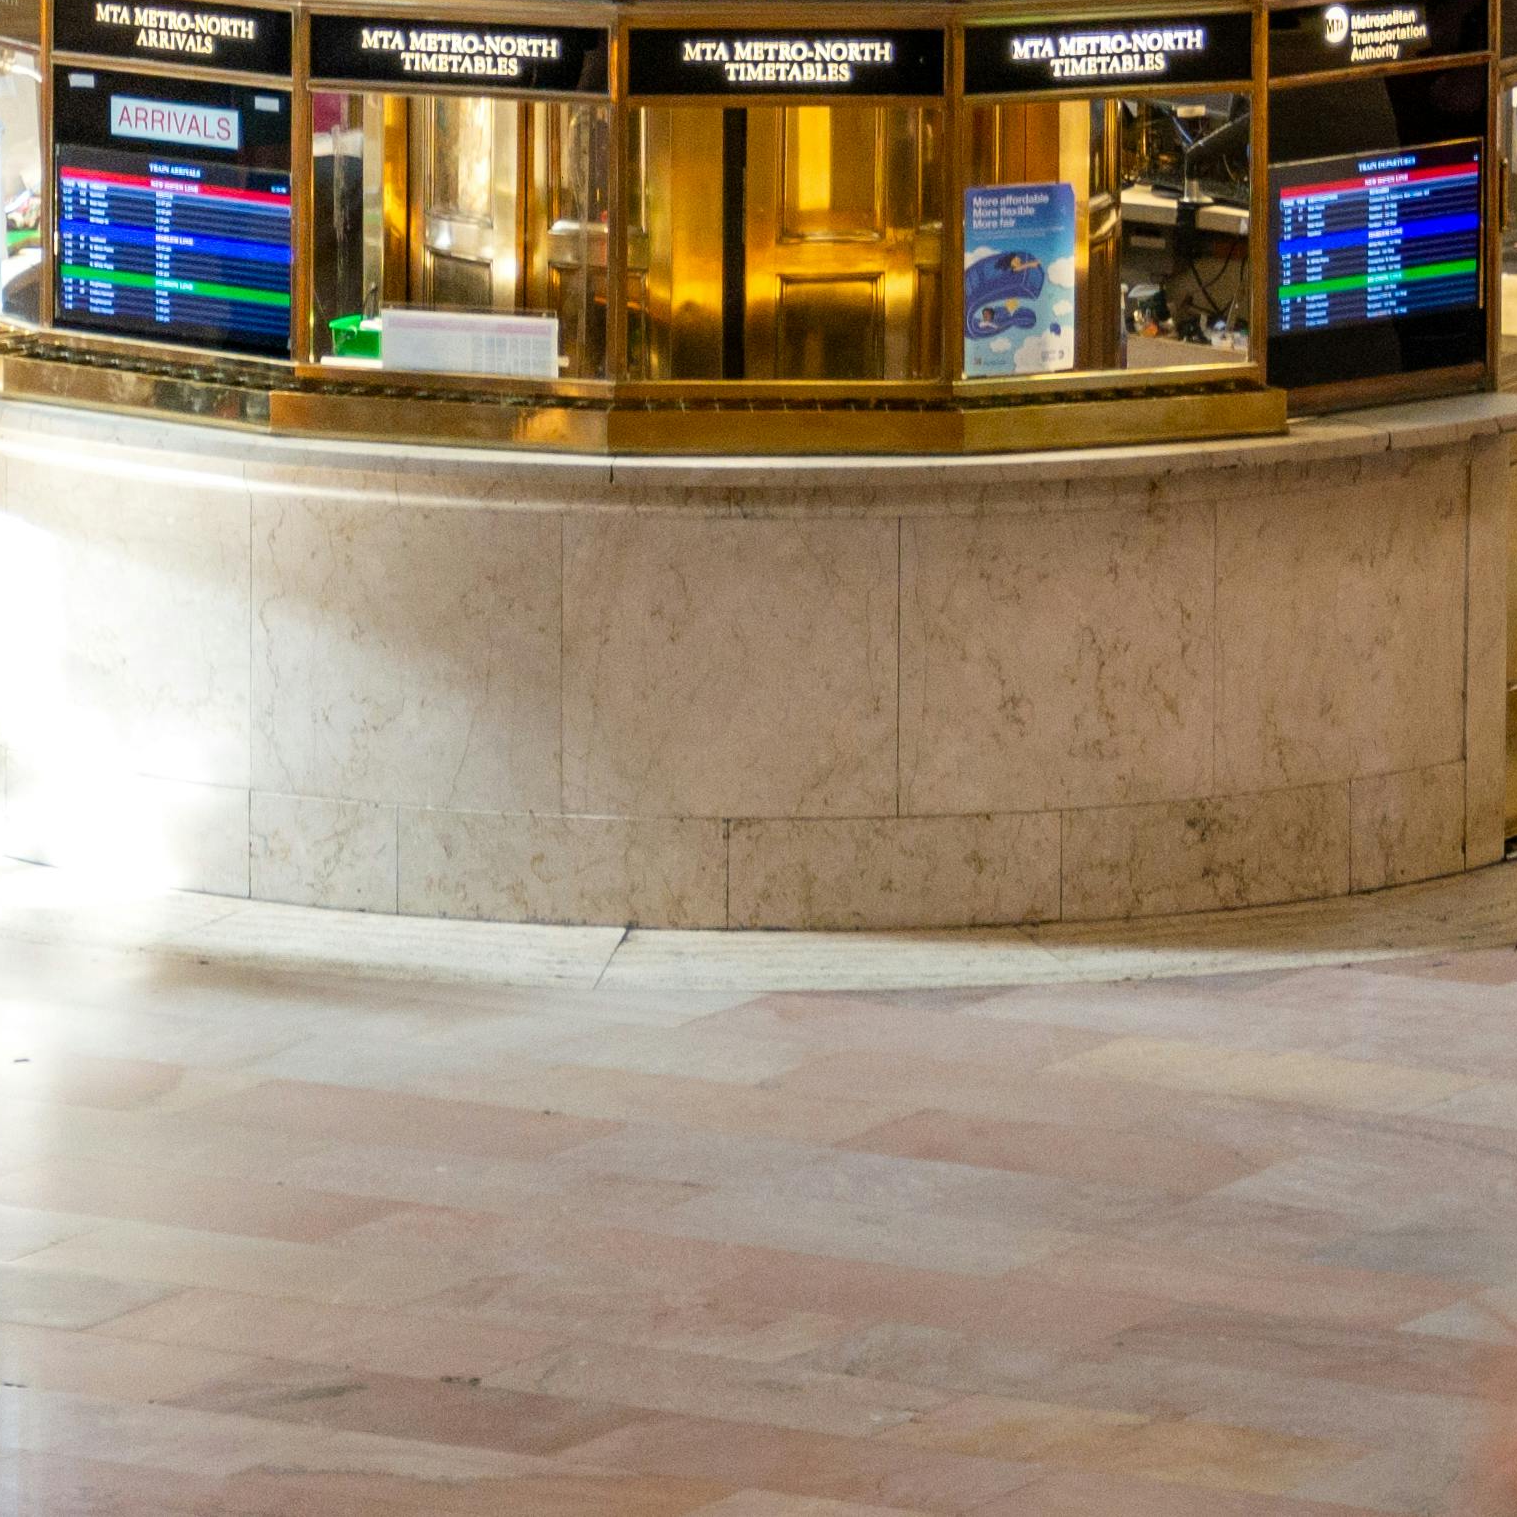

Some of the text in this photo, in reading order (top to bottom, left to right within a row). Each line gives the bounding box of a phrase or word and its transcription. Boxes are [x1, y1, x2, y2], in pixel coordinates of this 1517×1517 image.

[95, 2, 255, 39] MTA METRO-NORTH
[1350, 9, 1416, 30] Metropolitan
[136, 29, 213, 54] ARRIVALS
[362, 29, 557, 59] MTA METRO-NORTH
[1012, 29, 1203, 60] MTA METRO-NORTH
[1350, 24, 1428, 46] Transportation
[401, 52, 518, 77] TIMETABLES
[684, 42, 891, 63] MTA METRO-NORTH
[1050, 52, 1166, 77] TIMETABLES
[1350, 42, 1399, 62] Authority
[725, 63, 851, 82] TIMETABLES
[118, 105, 231, 141] ARRIVALS
